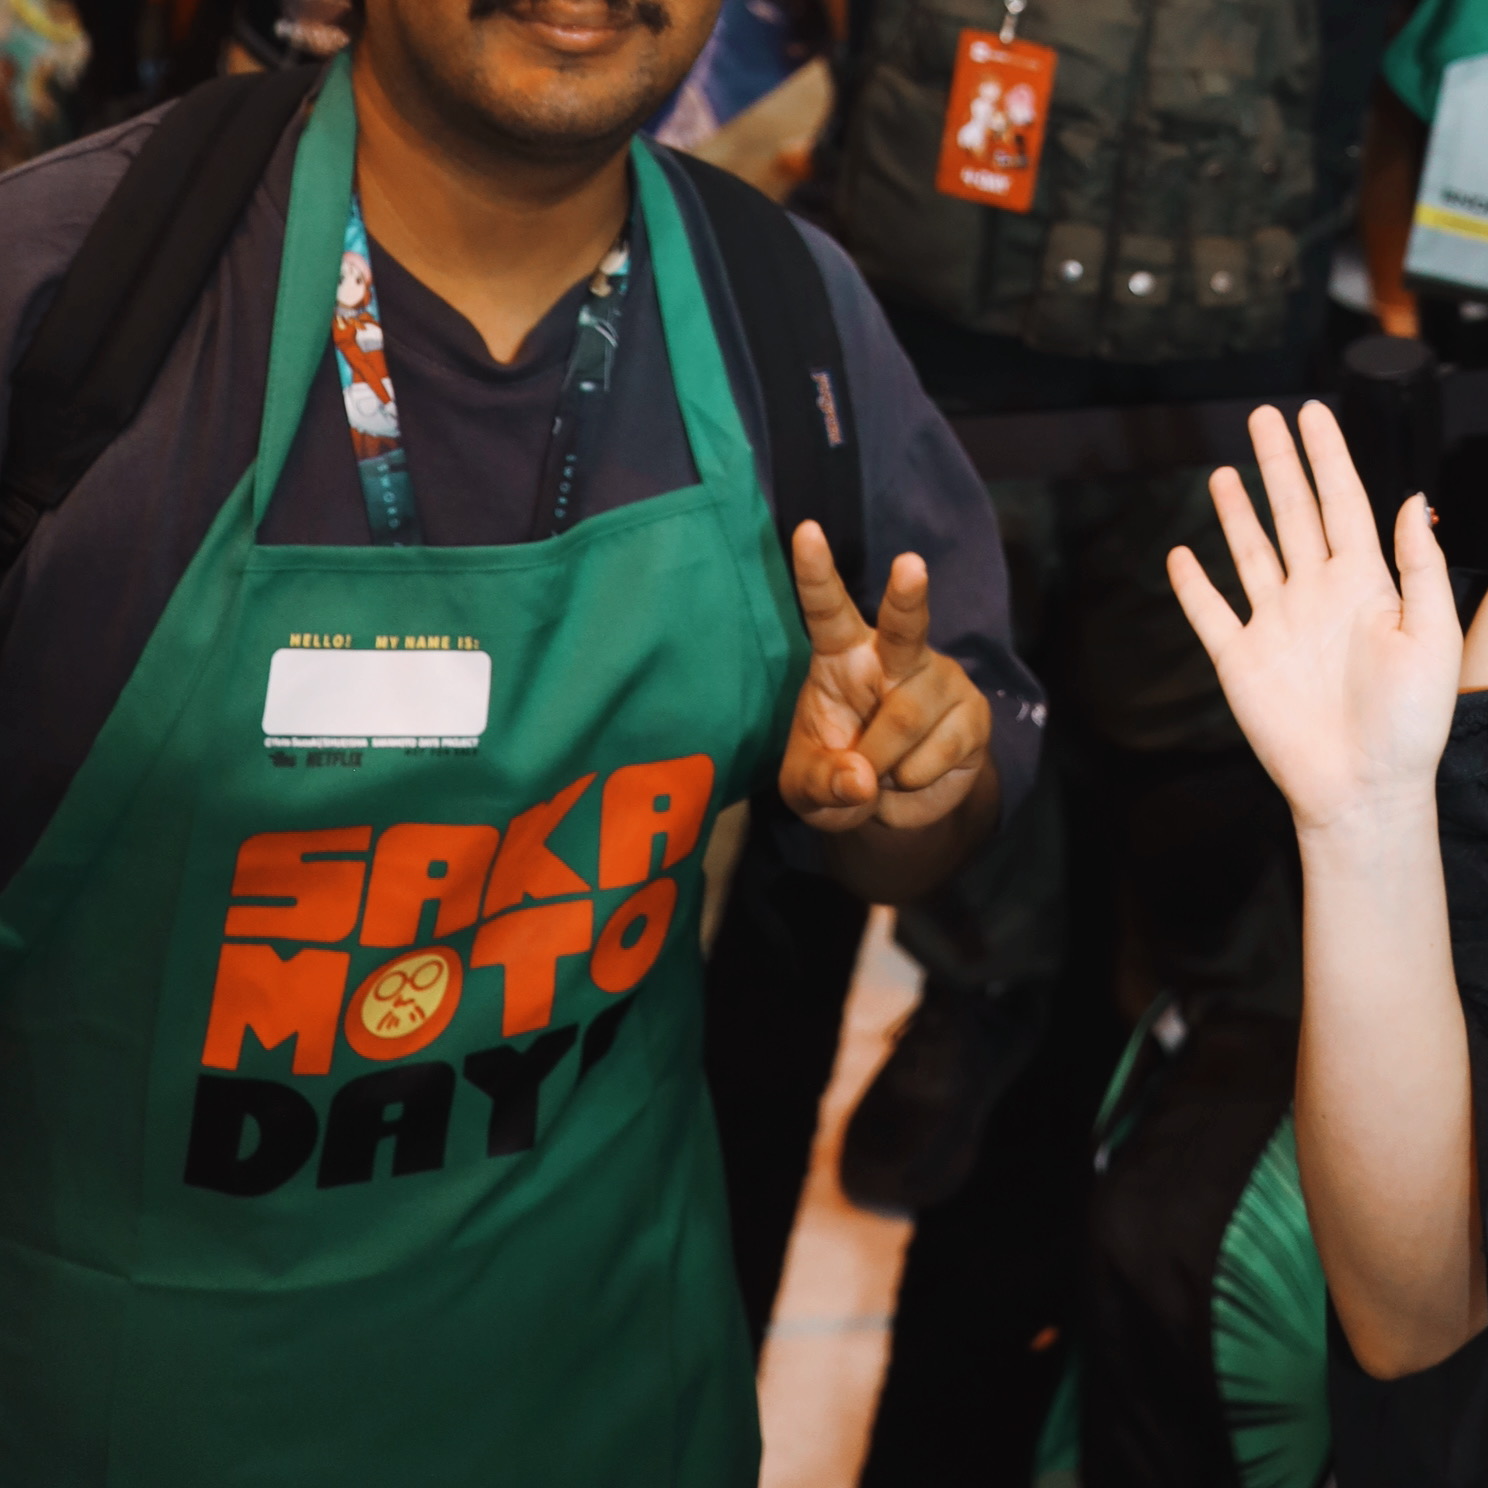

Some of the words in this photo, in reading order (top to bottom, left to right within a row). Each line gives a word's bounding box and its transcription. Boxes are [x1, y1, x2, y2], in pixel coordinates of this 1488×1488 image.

[289, 633, 351, 648] HELLO!
[375, 635, 399, 649] MY
[405, 635, 450, 649] NAME
[457, 636, 480, 650] IS:
[224, 753, 714, 947] SAKA
[202, 877, 677, 1075] MOTO
